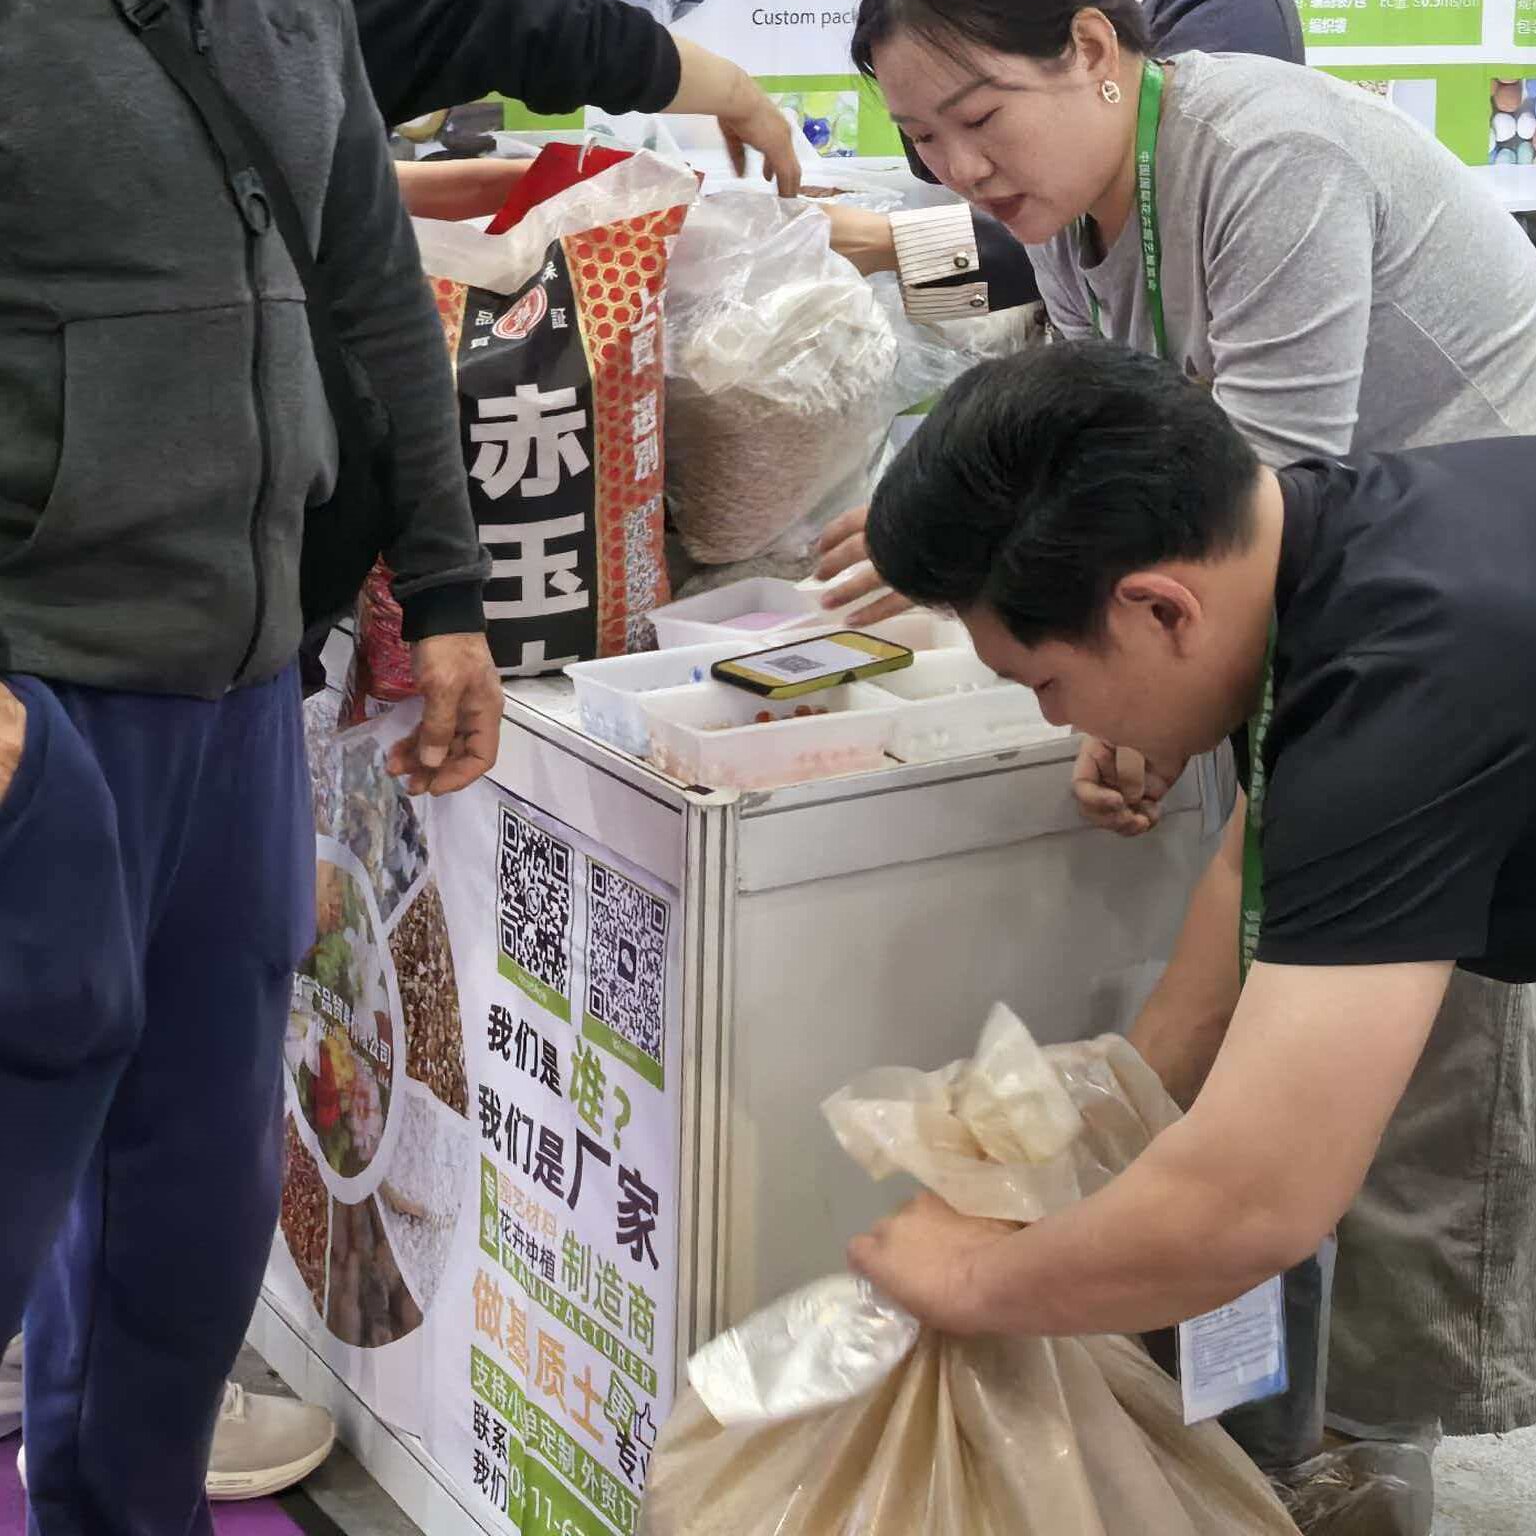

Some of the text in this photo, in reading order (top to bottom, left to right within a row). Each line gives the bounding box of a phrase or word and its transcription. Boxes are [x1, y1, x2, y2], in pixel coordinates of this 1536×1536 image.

[752, 8, 816, 26] Custom
[479, 1082, 660, 1271] 我们是厂家
[503, 1248, 652, 1389] MANUFACTURER
[561, 1229, 656, 1356] 制造商
